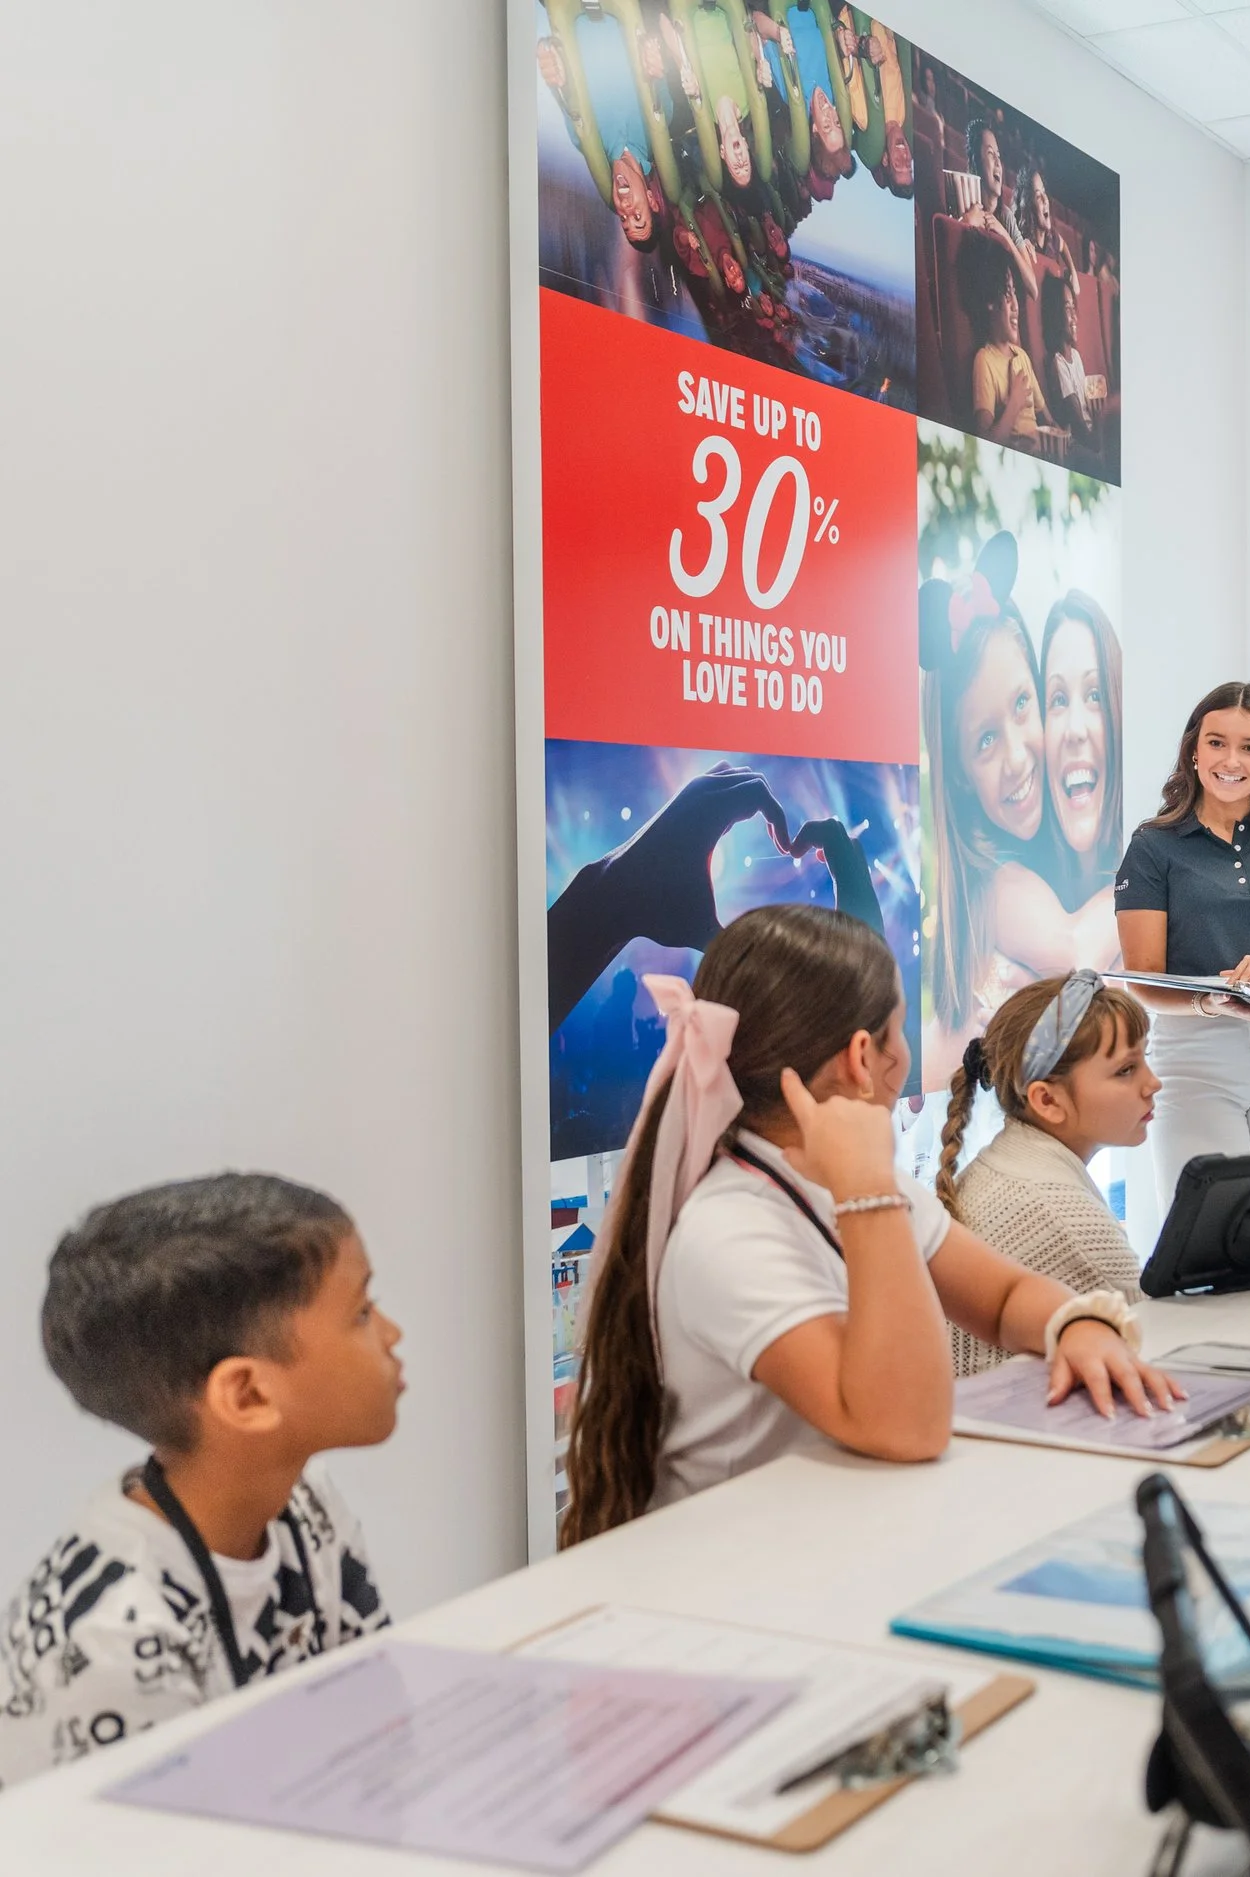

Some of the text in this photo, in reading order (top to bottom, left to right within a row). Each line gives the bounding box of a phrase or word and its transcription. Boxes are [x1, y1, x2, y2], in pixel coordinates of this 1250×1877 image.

[677, 370, 822, 452] SAVE UP TO
[669, 435, 840, 610] 30%
[650, 605, 848, 675] ON THINGS YOU
[682, 659, 824, 715] LOVE TO DO
